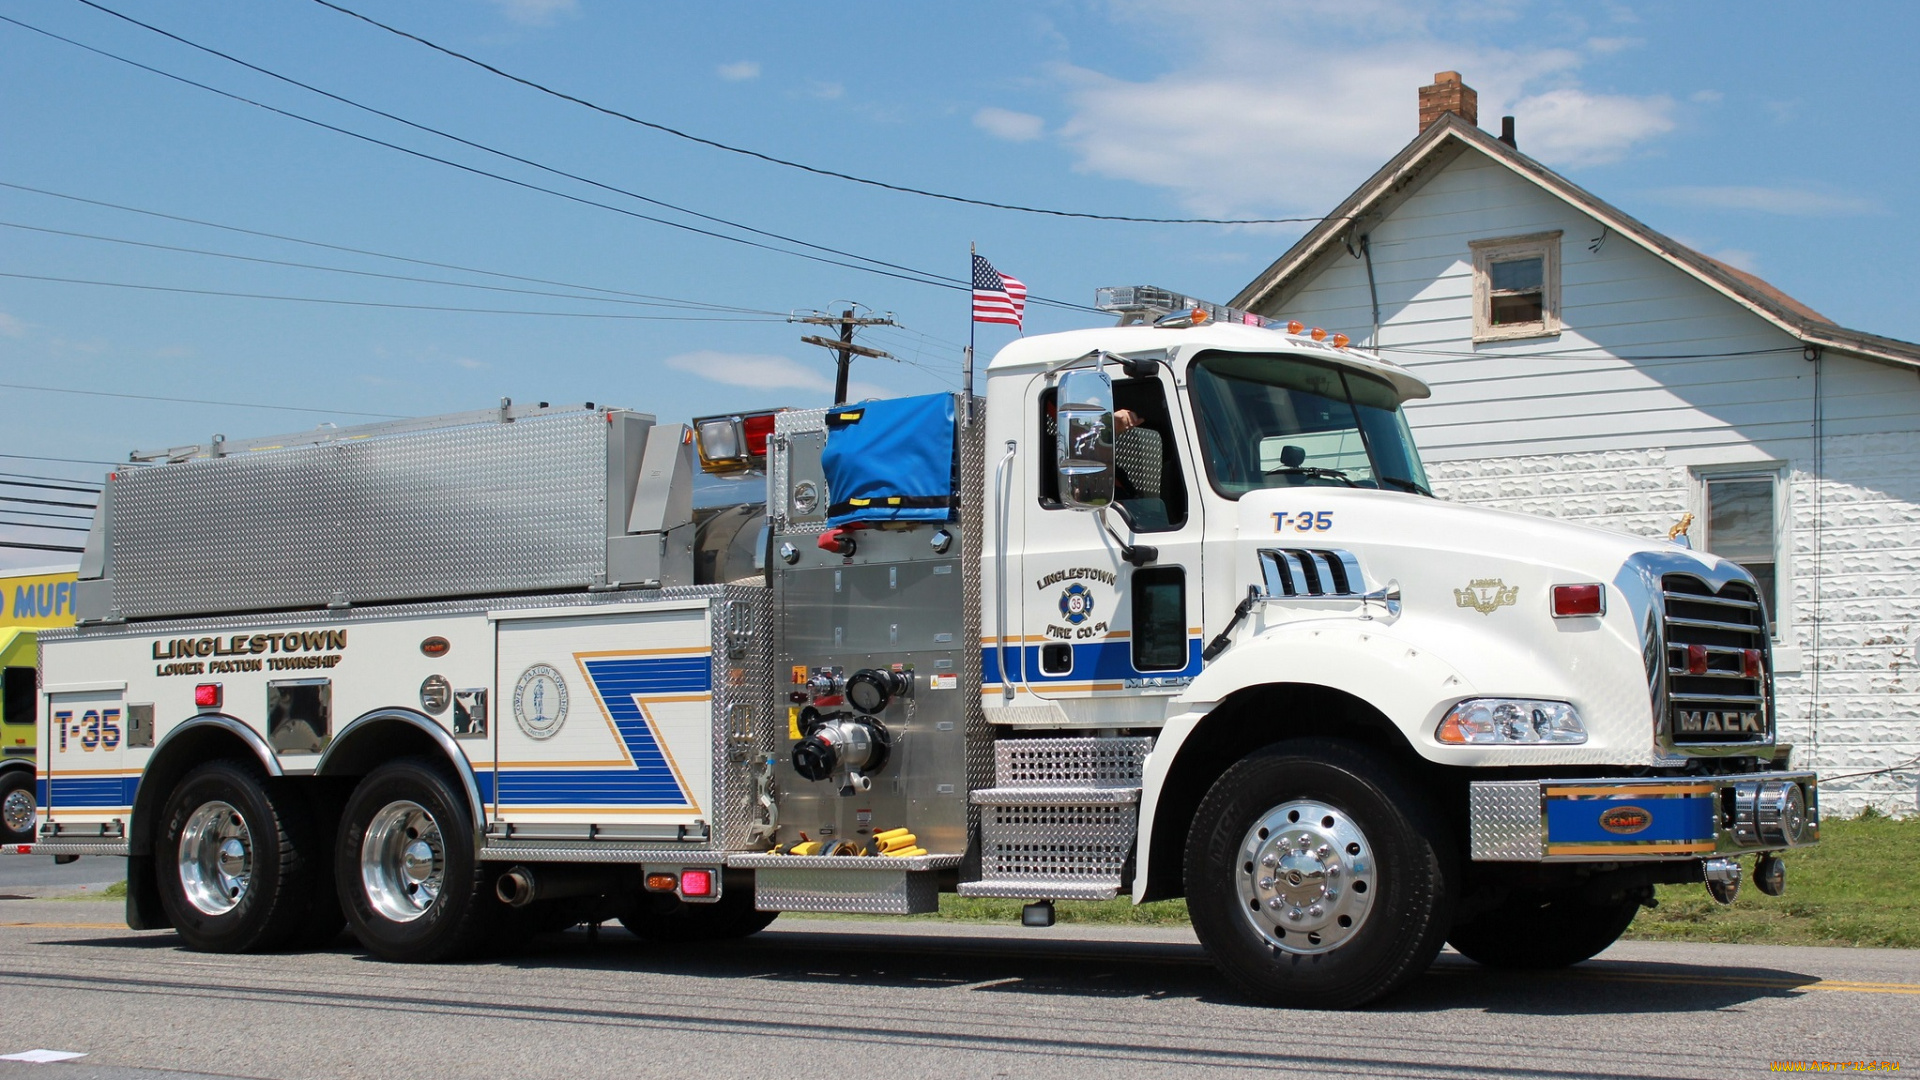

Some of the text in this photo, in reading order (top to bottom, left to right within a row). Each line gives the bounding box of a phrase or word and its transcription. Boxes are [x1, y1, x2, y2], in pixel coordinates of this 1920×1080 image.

[1270, 511, 1333, 533] T-35
[1037, 567, 1117, 590] LINGLESTOWN
[1071, 598, 1082, 610] 35
[1046, 624, 1072, 639] FIRE
[153, 629, 347, 660] LINGLESTOWN
[157, 655, 342, 676] LOWER PAXTON TOWNSHIP
[1125, 677, 1195, 688] MACK
[54, 708, 120, 753] T-35
[1680, 711, 1759, 731] MACK
